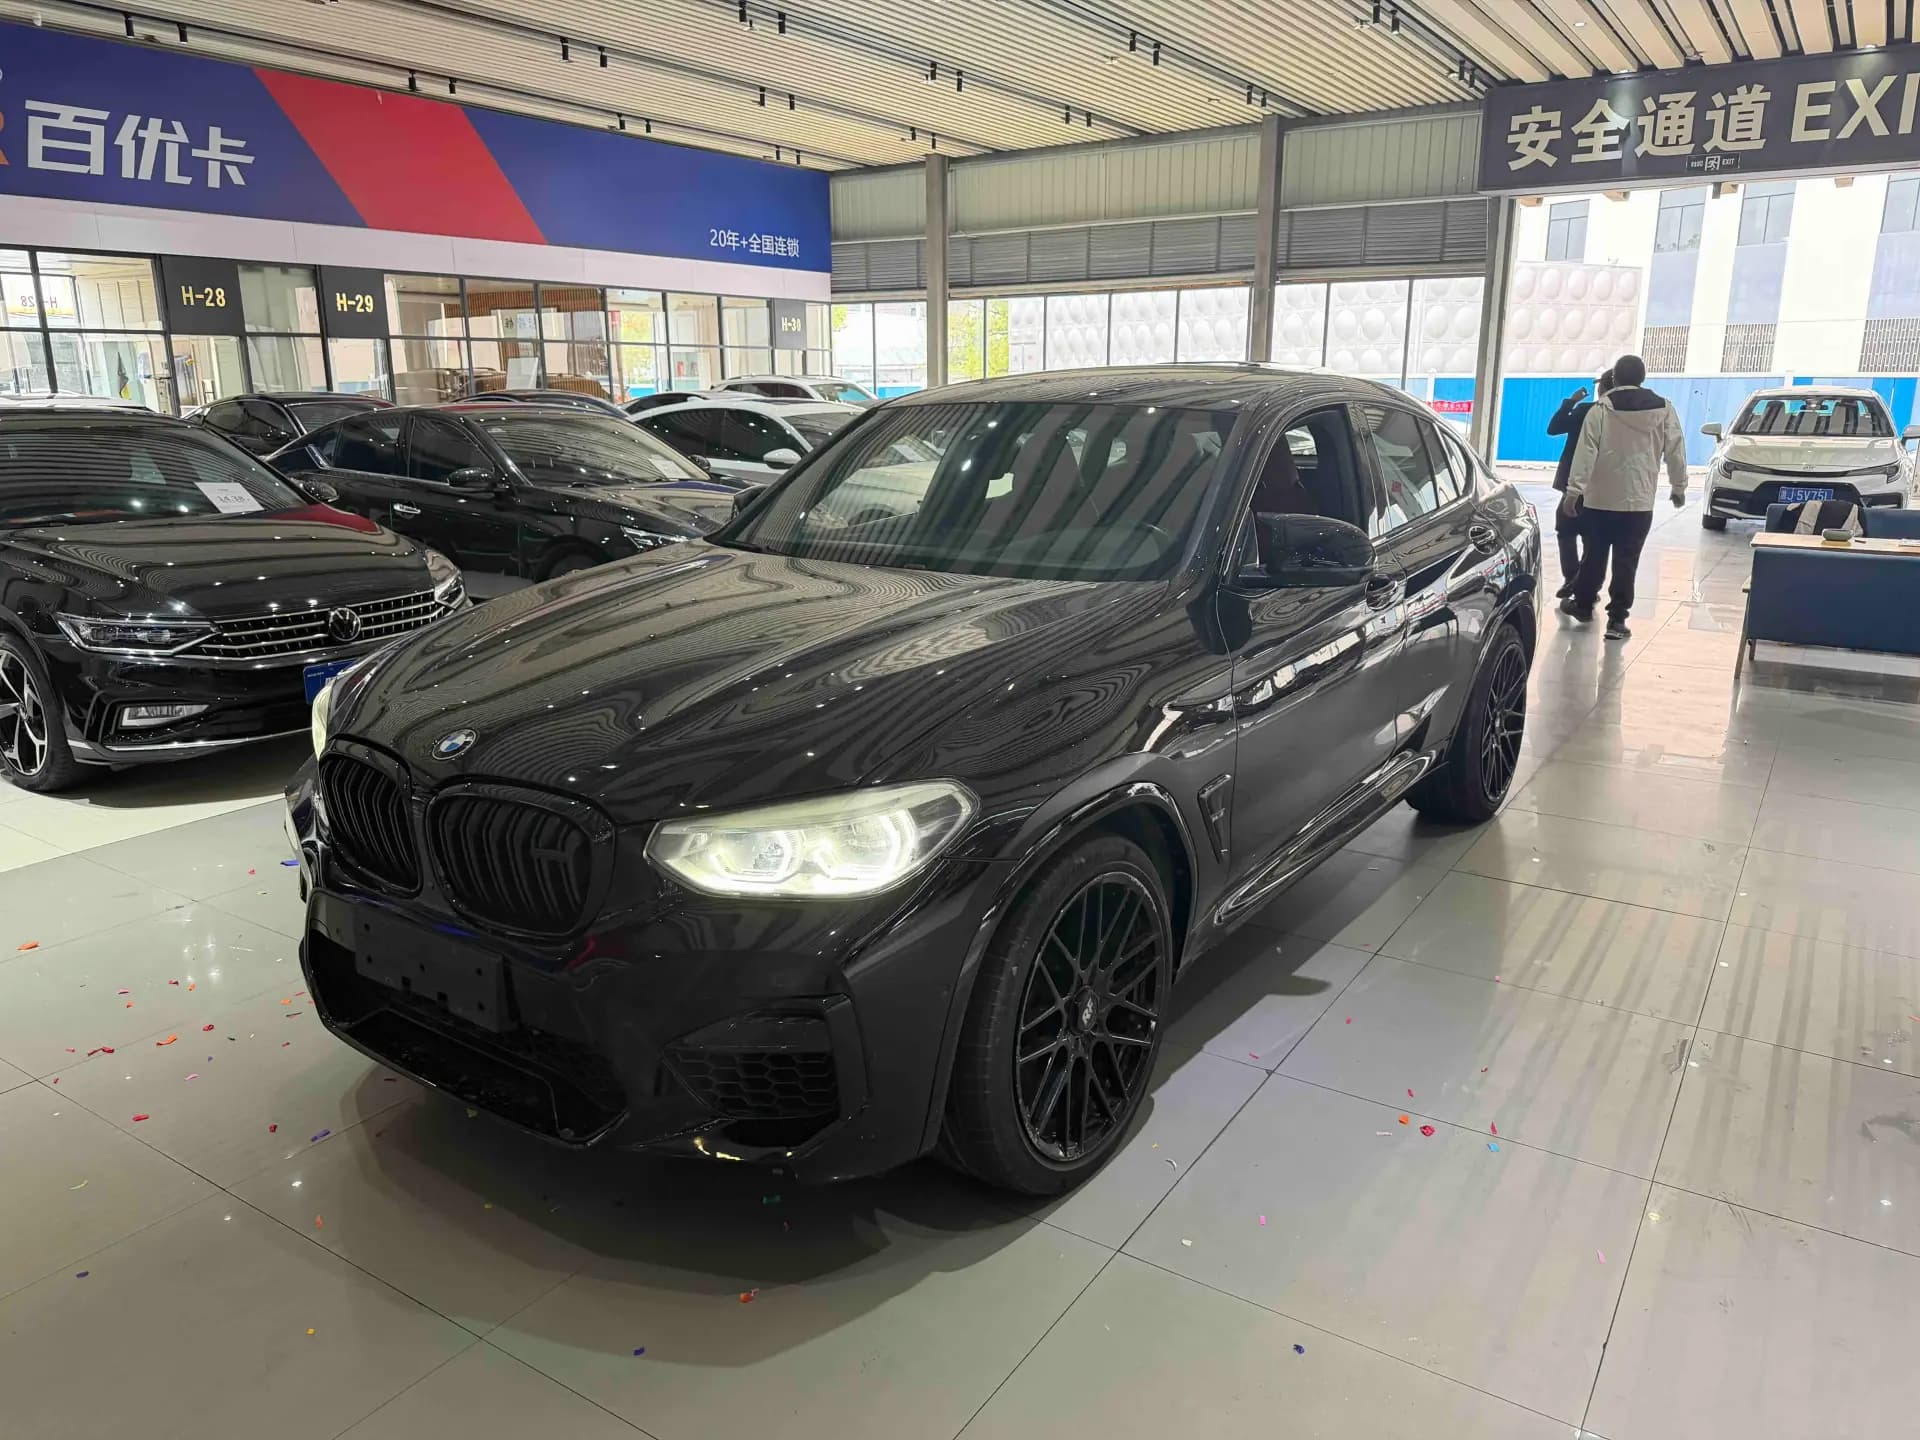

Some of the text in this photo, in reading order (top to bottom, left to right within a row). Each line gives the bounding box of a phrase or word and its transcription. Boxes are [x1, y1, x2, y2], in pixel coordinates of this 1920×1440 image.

[1507, 84, 1771, 170] 安全通道
[25, 99, 256, 189] 百优卡
[710, 229, 799, 257] 20年+全国连锁
[180, 285, 227, 308] H-28
[335, 292, 375, 313] H-29
[781, 316, 802, 332] H-30
